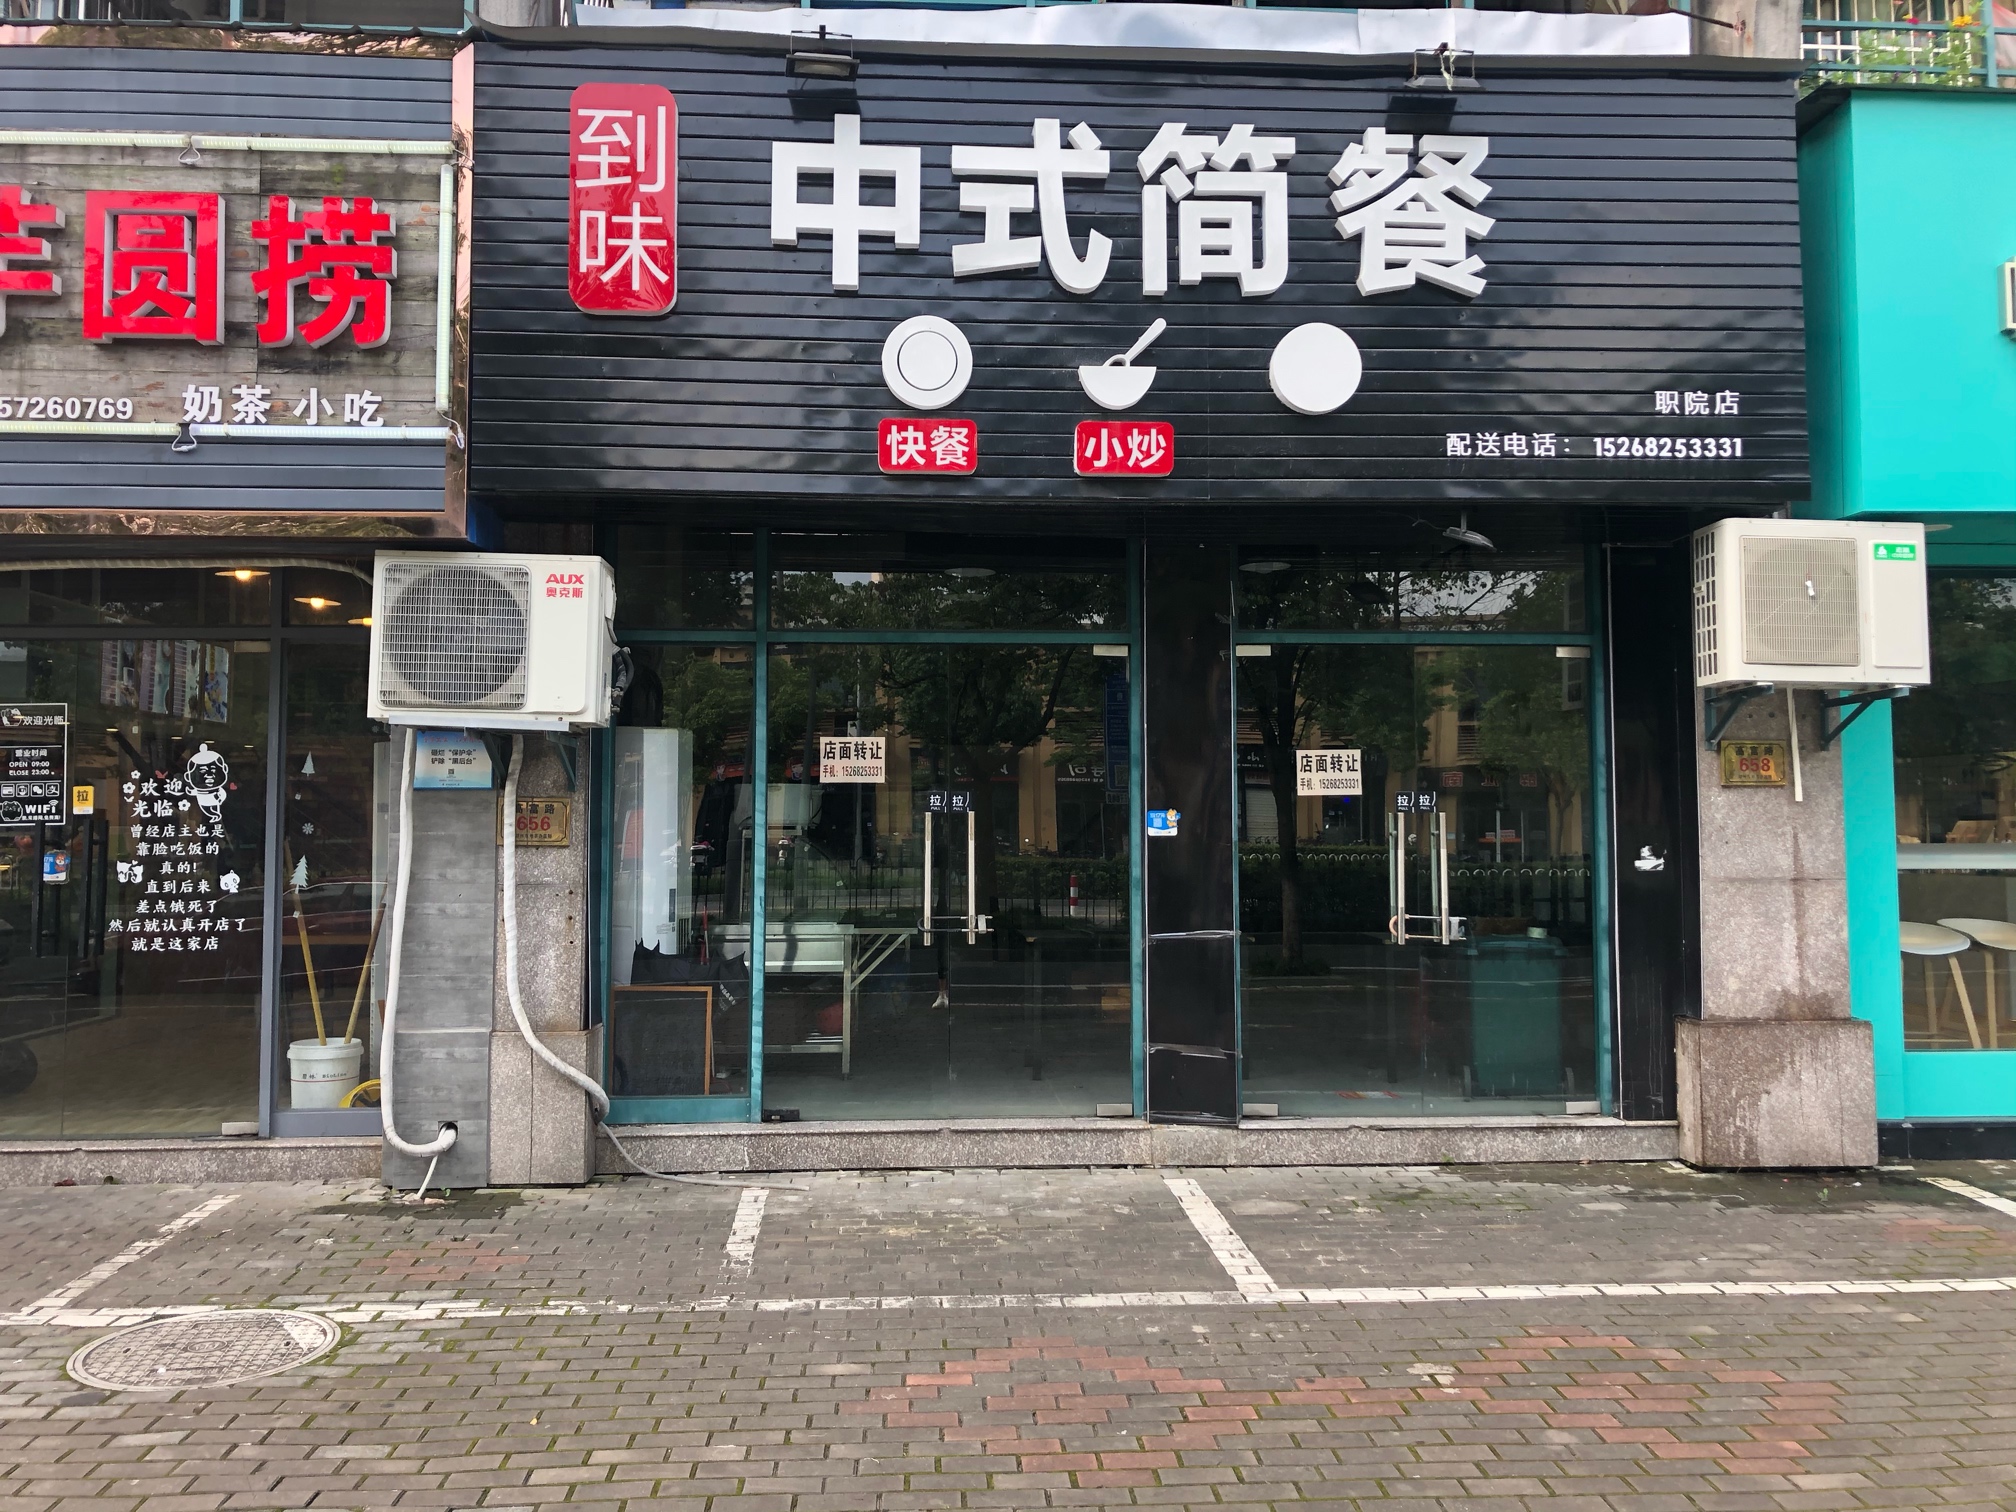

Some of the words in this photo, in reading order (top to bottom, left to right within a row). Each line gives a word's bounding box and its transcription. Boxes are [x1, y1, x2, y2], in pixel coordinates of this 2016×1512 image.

[576, 105, 670, 291] 到味
[771, 113, 1497, 298] 中式简餐
[0, 397, 133, 420] 57260769
[182, 384, 272, 424] 奶茶
[293, 387, 385, 428] 小吃
[1654, 389, 1740, 415] 职院店
[886, 424, 970, 467] 快餐
[1084, 427, 1168, 469] 小炒
[1593, 437, 1742, 457] 15268253331
[546, 573, 584, 584] AUX
[546, 587, 583, 598] 奥克斯
[823, 740, 883, 761] 店面转让
[1299, 753, 1359, 774] 店面转让
[1739, 757, 1771, 772] 658
[139, 778, 186, 797] 欢迎
[76, 789, 89, 803] 拉
[930, 794, 942, 807] 拉
[952, 794, 964, 807] 拉
[1397, 794, 1409, 807] 拉
[1419, 794, 1431, 807] 拉
[131, 799, 174, 818] 光临
[516, 815, 551, 831] 656
[130, 824, 226, 839] 曾经店主也是
[135, 842, 220, 856] 靠脸吃饭的
[144, 879, 212, 894] 直到后来
[135, 900, 218, 914] 差点饿死了
[108, 918, 247, 932] 然后就认真开店了
[131, 936, 220, 952] 就是这家店
